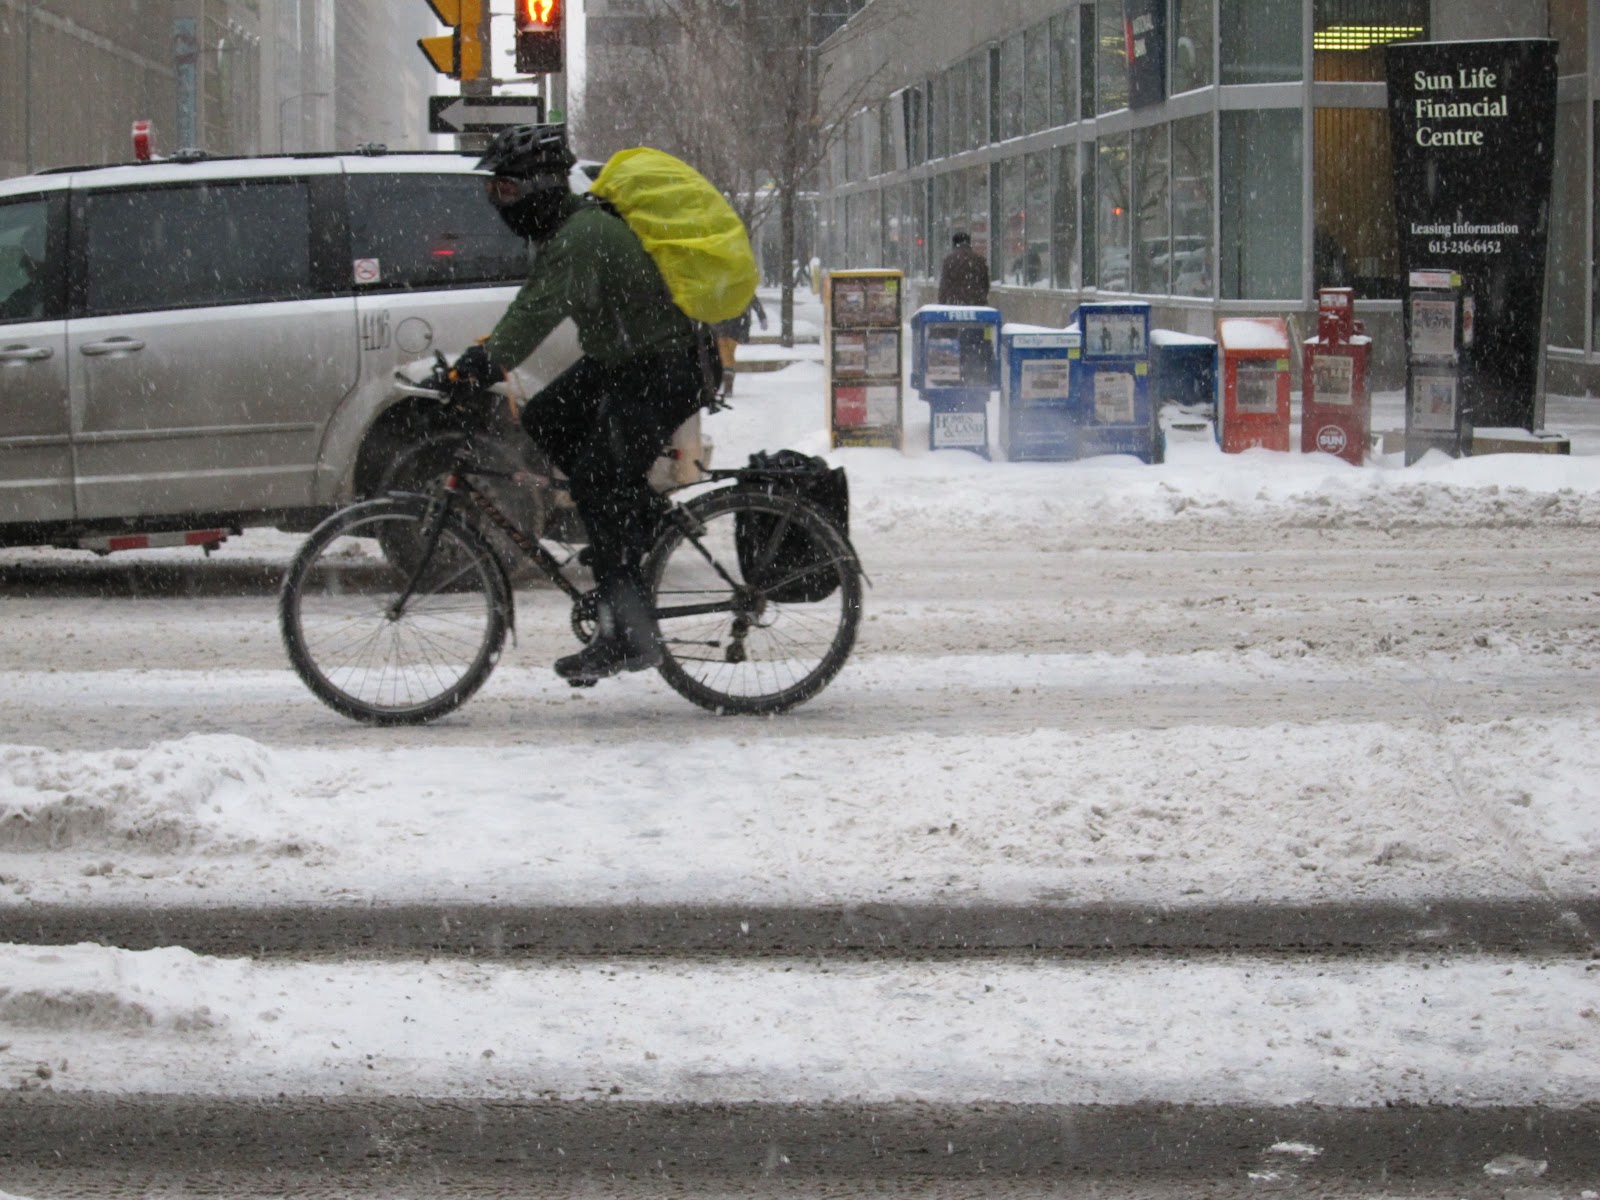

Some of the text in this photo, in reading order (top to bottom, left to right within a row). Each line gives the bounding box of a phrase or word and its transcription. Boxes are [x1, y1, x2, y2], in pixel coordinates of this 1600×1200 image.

[1414, 66, 1497, 91] Sun Life
[1415, 95, 1508, 118] Financial
[1416, 126, 1484, 147] Centre
[1411, 221, 1519, 238] Leasing Information
[1428, 240, 1502, 255] 613-236-6452
[948, 310, 977, 321] FREE
[1319, 434, 1345, 446] SUN
